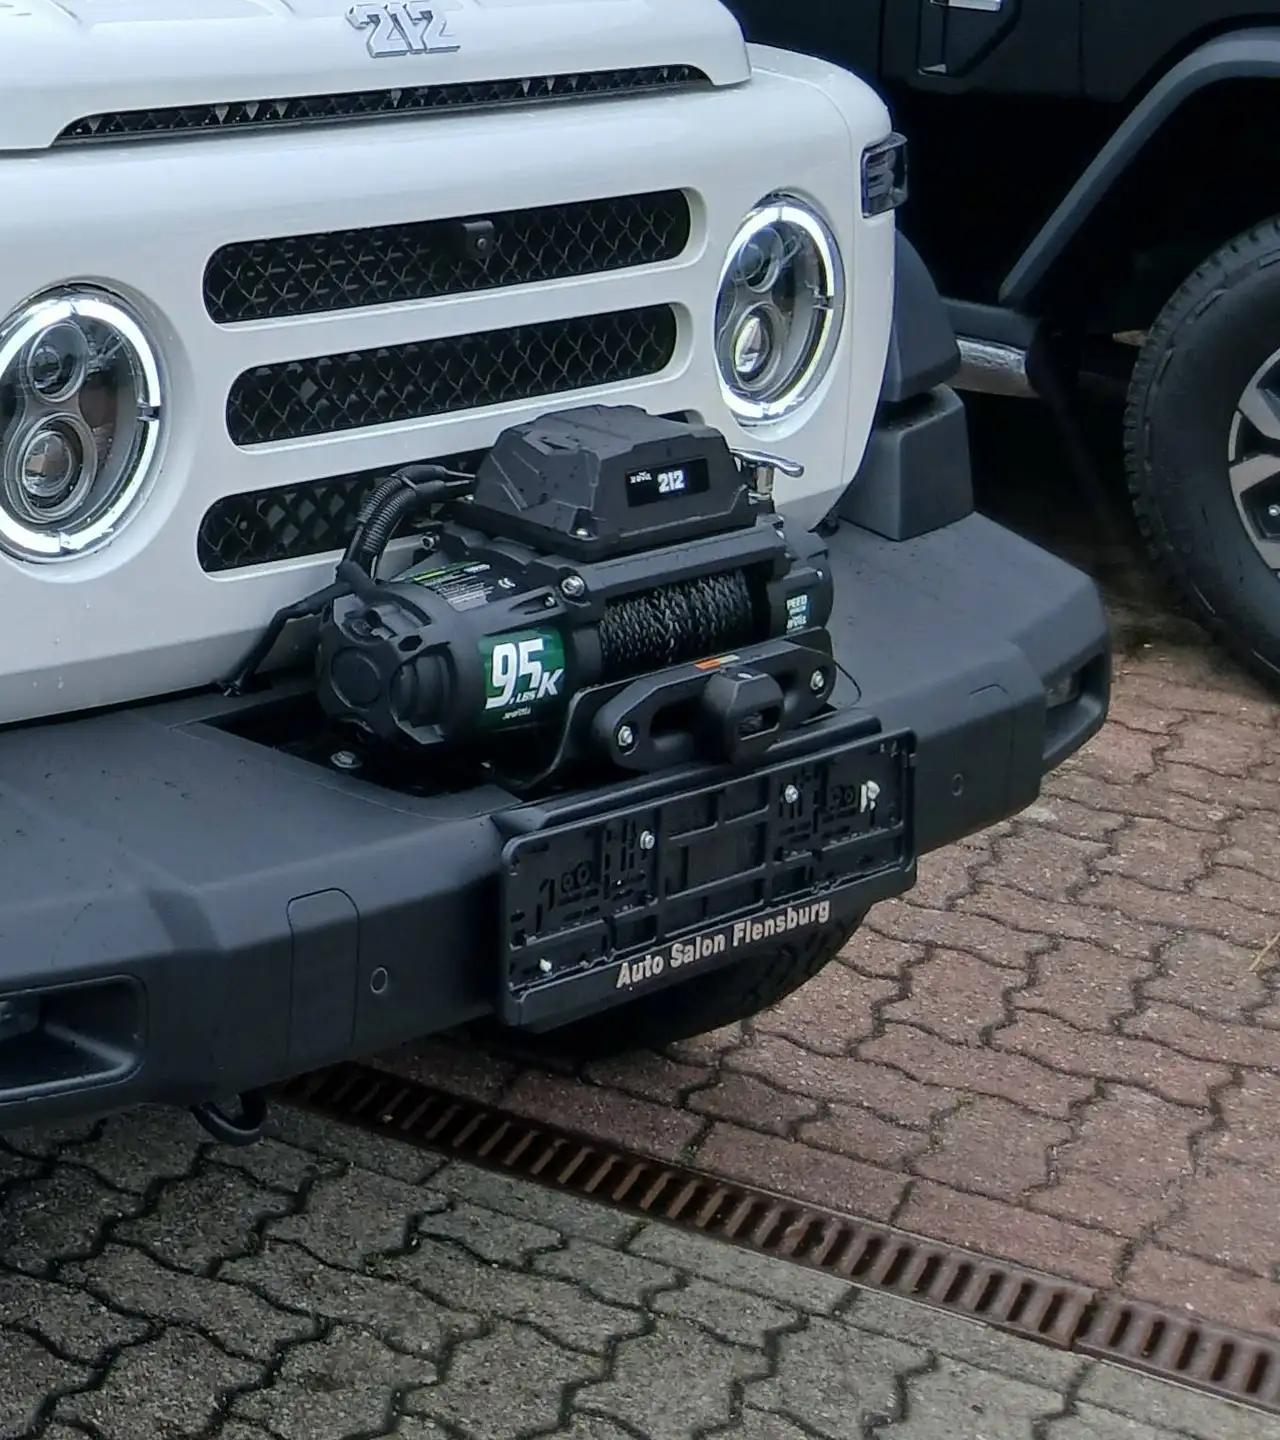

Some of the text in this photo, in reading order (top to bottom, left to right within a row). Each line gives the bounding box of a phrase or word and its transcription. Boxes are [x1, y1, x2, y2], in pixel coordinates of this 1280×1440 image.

[345, 1, 461, 59] 212
[657, 469, 686, 494] 212
[616, 900, 830, 989] Auto Salon Flensburg
